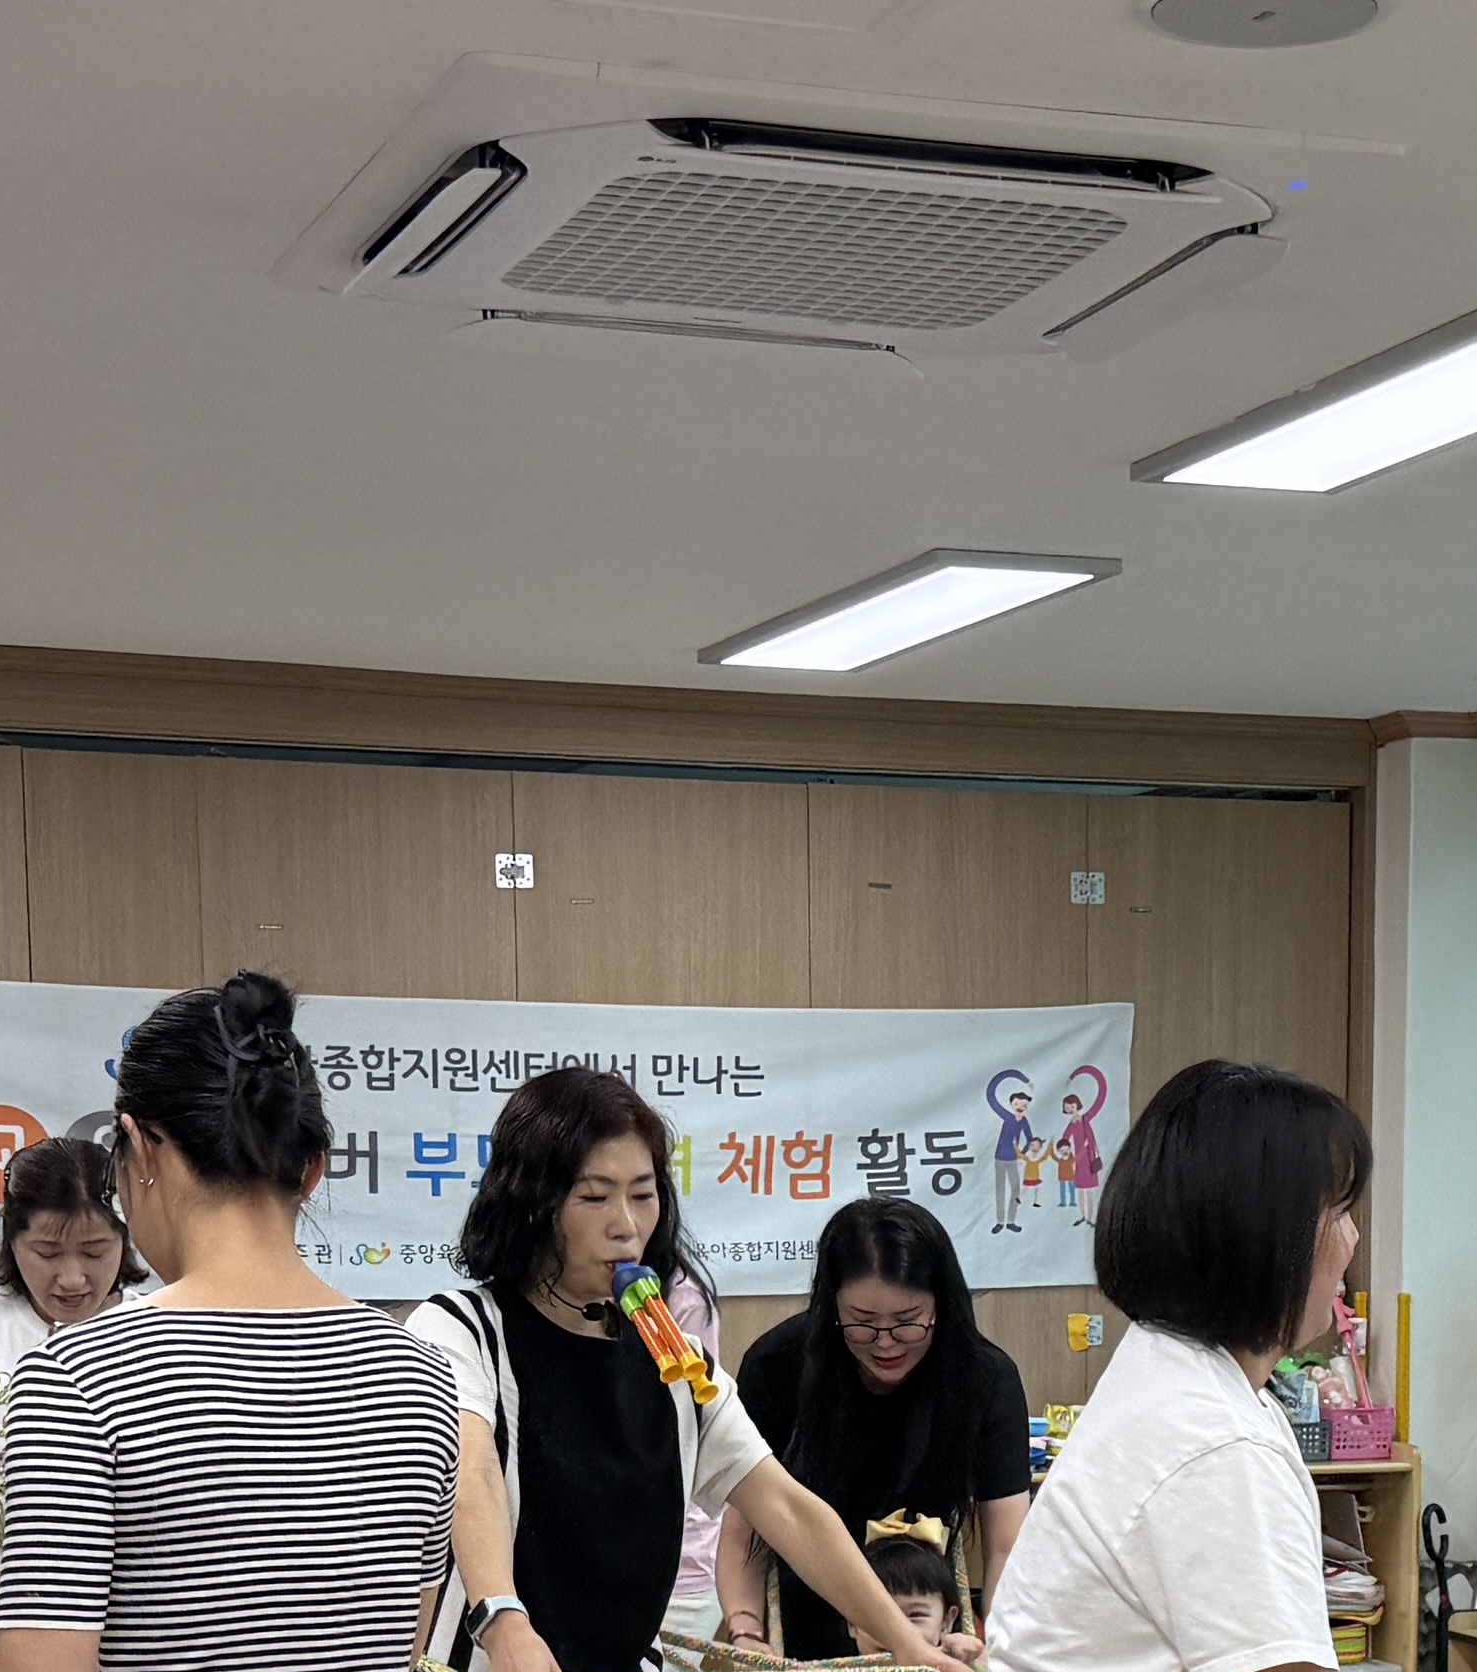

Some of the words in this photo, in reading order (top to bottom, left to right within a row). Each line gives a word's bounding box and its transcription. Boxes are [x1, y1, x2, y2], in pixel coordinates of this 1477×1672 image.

[651, 1053, 765, 1097] 만나는
[717, 1130, 833, 1200] 체험
[856, 1128, 975, 1197] 활동
